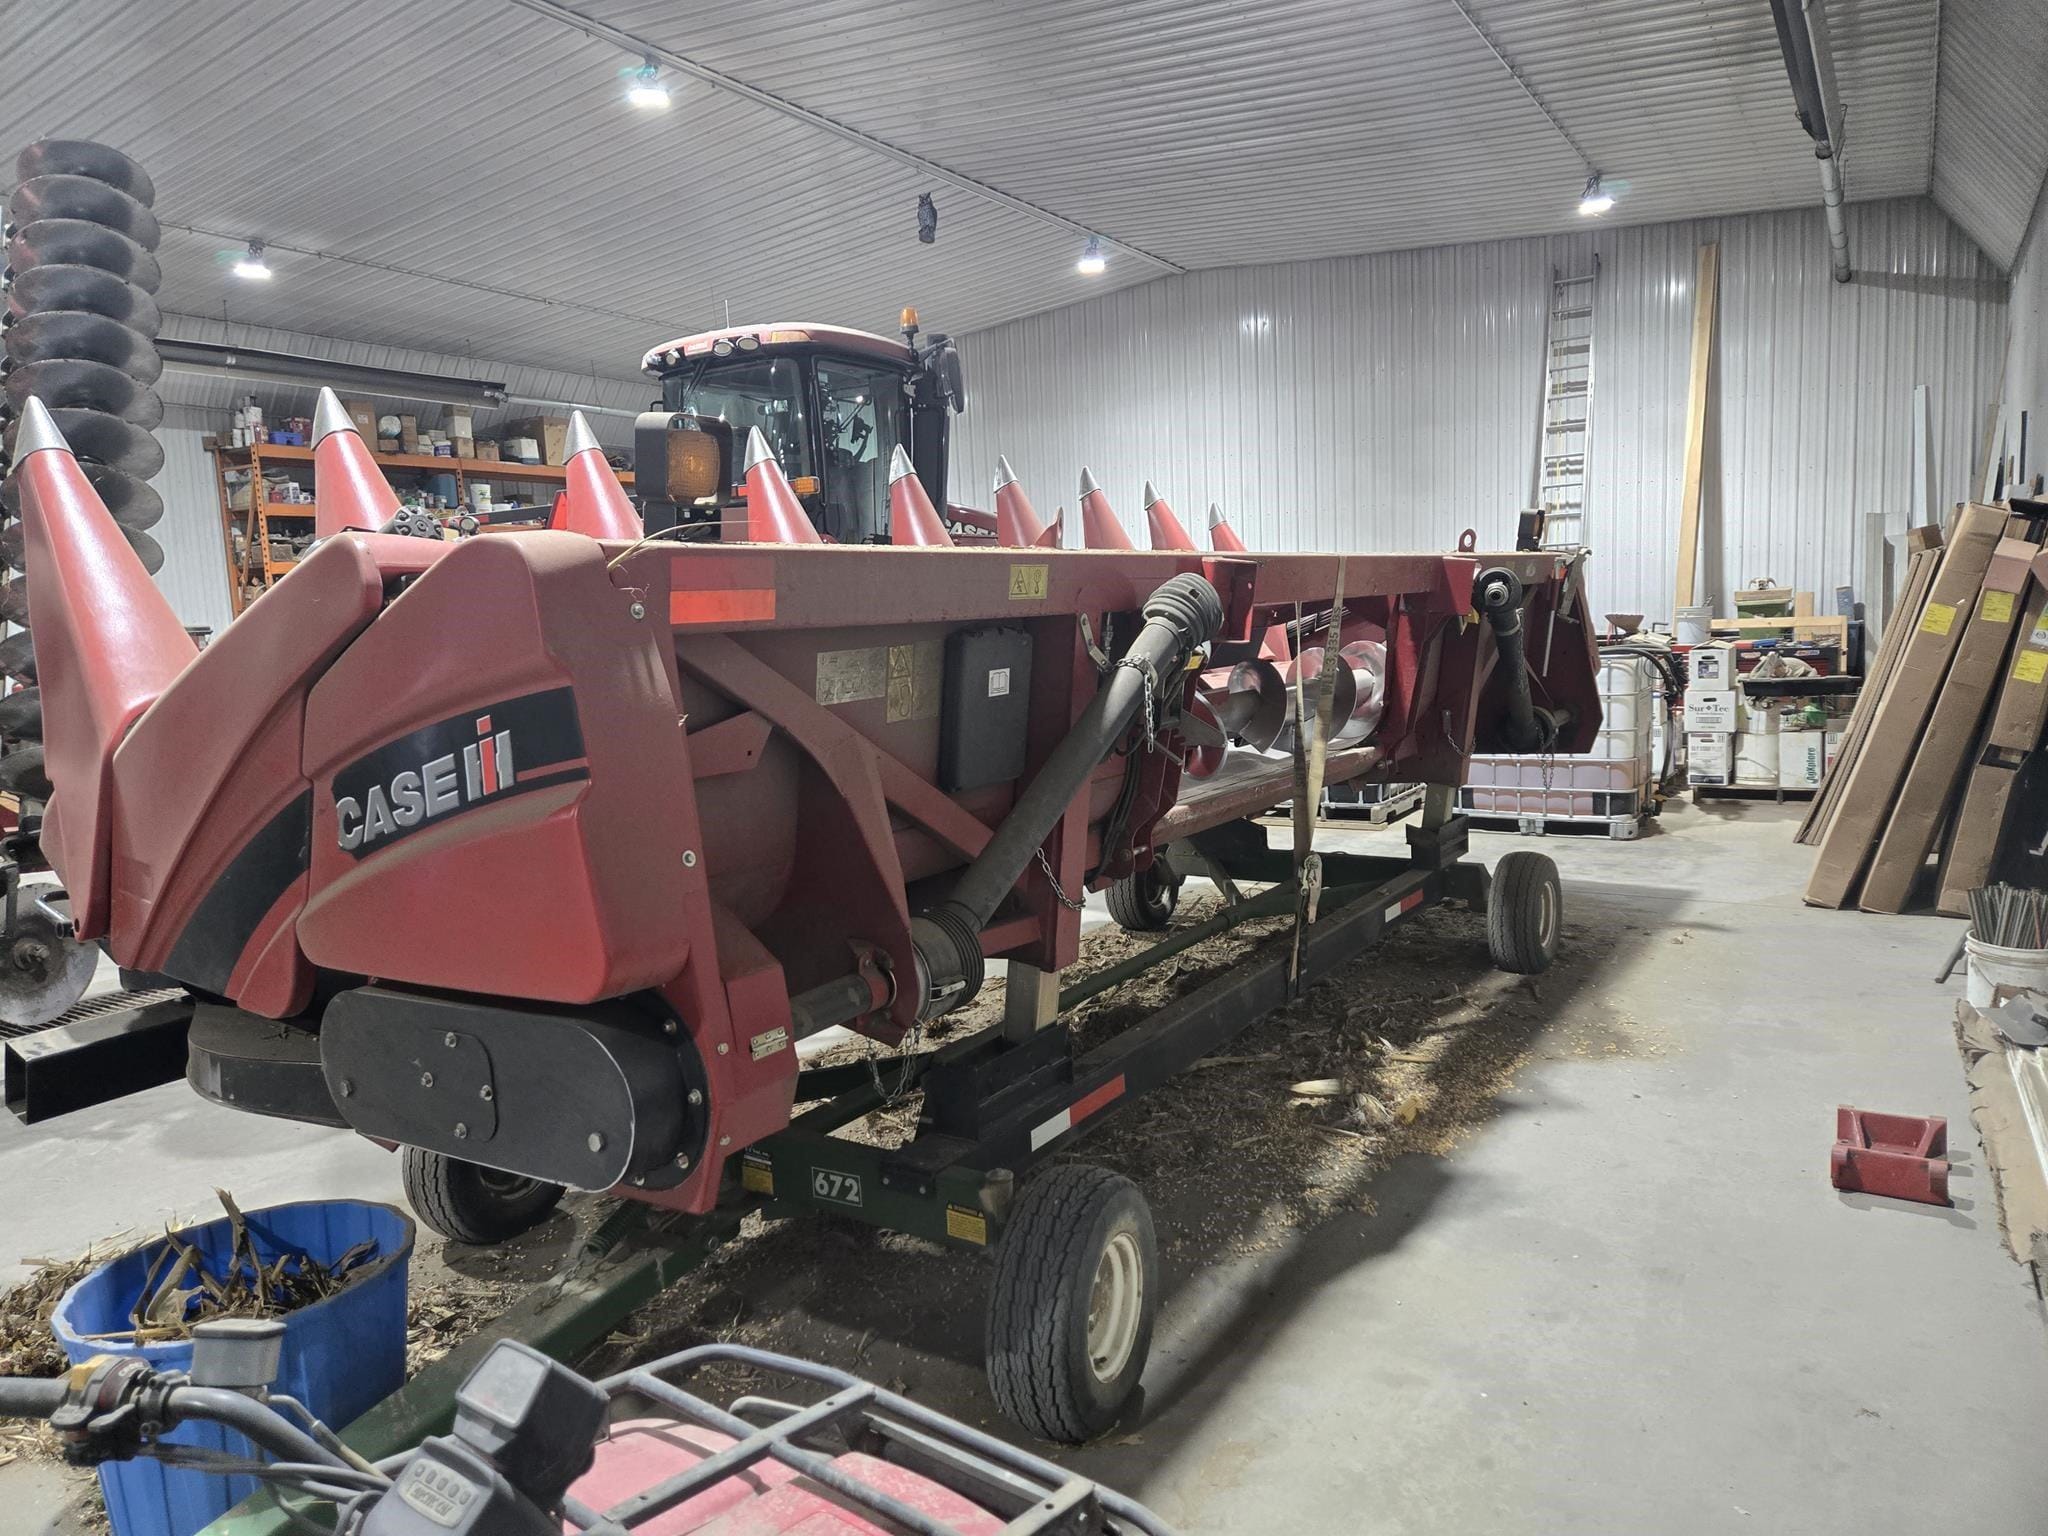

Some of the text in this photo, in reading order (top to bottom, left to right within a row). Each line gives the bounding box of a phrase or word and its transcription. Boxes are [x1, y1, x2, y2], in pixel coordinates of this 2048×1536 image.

[1331, 606, 1341, 629] LBS
[1325, 631, 1340, 666] 3,335
[335, 714, 515, 850] CASE IH
[814, 1172, 860, 1203] 672
